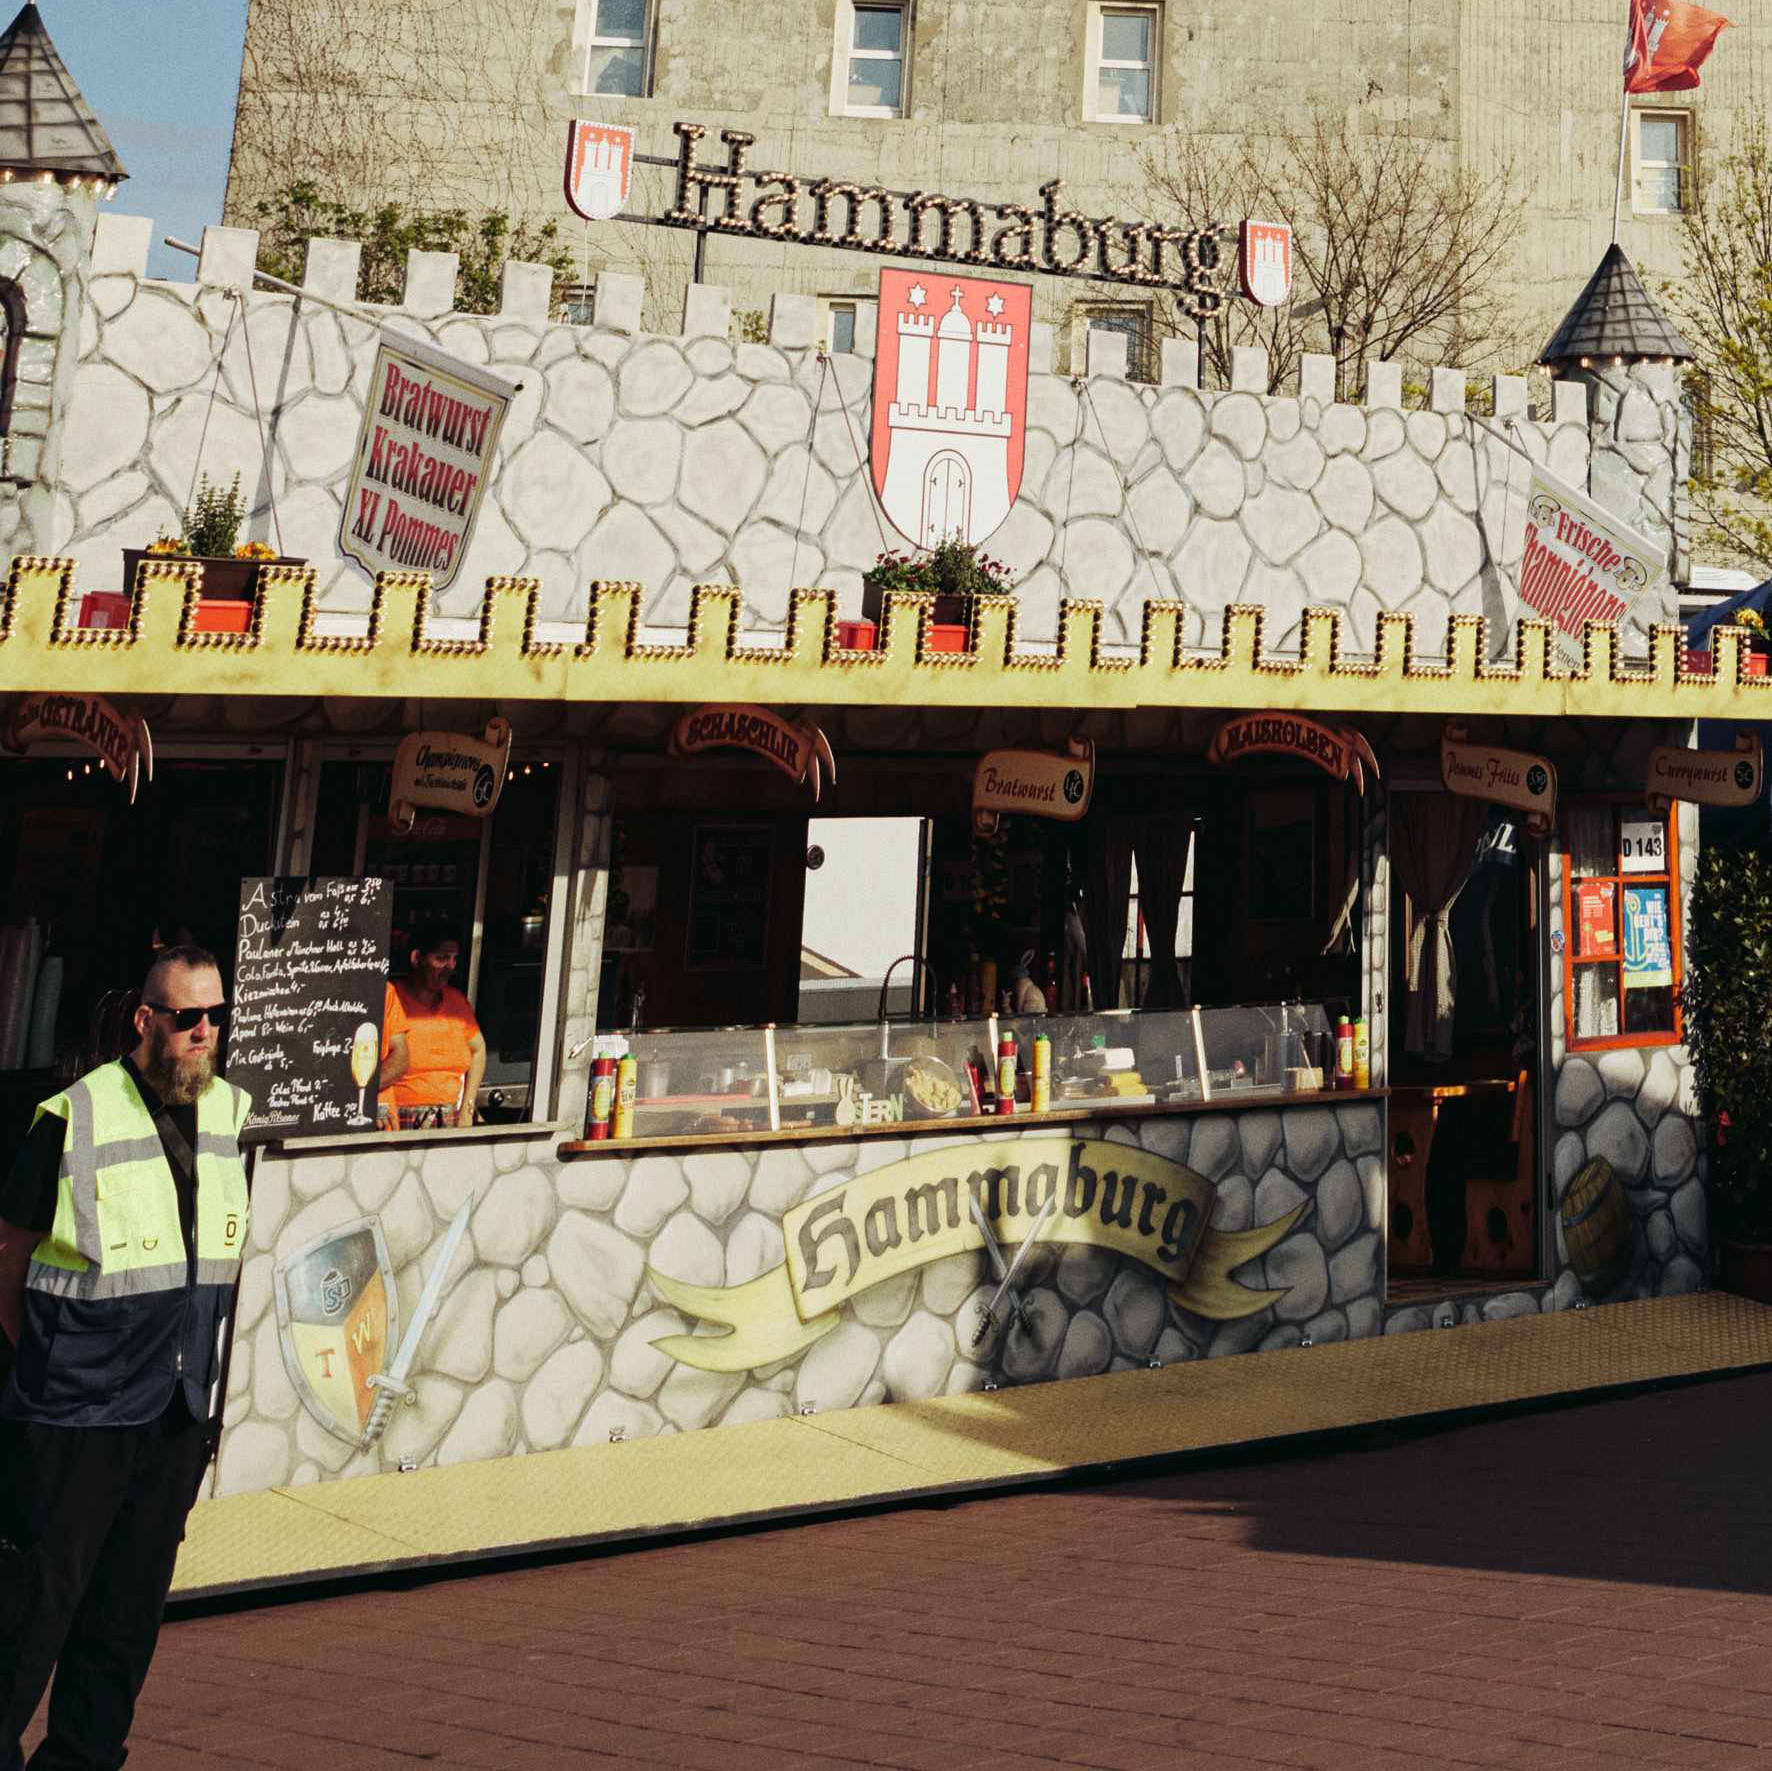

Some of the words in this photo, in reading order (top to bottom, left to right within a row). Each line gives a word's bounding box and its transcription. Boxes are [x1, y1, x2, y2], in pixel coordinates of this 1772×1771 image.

[664, 122, 1235, 319] Hammaburg
[379, 362, 490, 458] Bratwurst
[365, 425, 477, 517] Krakauer
[351, 487, 381, 544] XL
[376, 498, 459, 572] Pommes
[1556, 511, 1621, 572] Frische
[687, 713, 799, 771] SCHASCHLIK
[984, 767, 1056, 801] Bratwurst
[1446, 751, 1482, 780] Pommes
[1487, 758, 1520, 787] Frites
[1656, 756, 1728, 787] Currywurst
[1622, 838, 1632, 857] D
[1636, 838, 1662, 857] 143
[242, 883, 300, 911] Astra
[304, 893, 323, 904] vom
[238, 938, 285, 963] Paulaner
[313, 1102, 341, 1122] Kaffee
[798, 1142, 1199, 1293] Hammaburg
[314, 1347, 336, 1379] T
